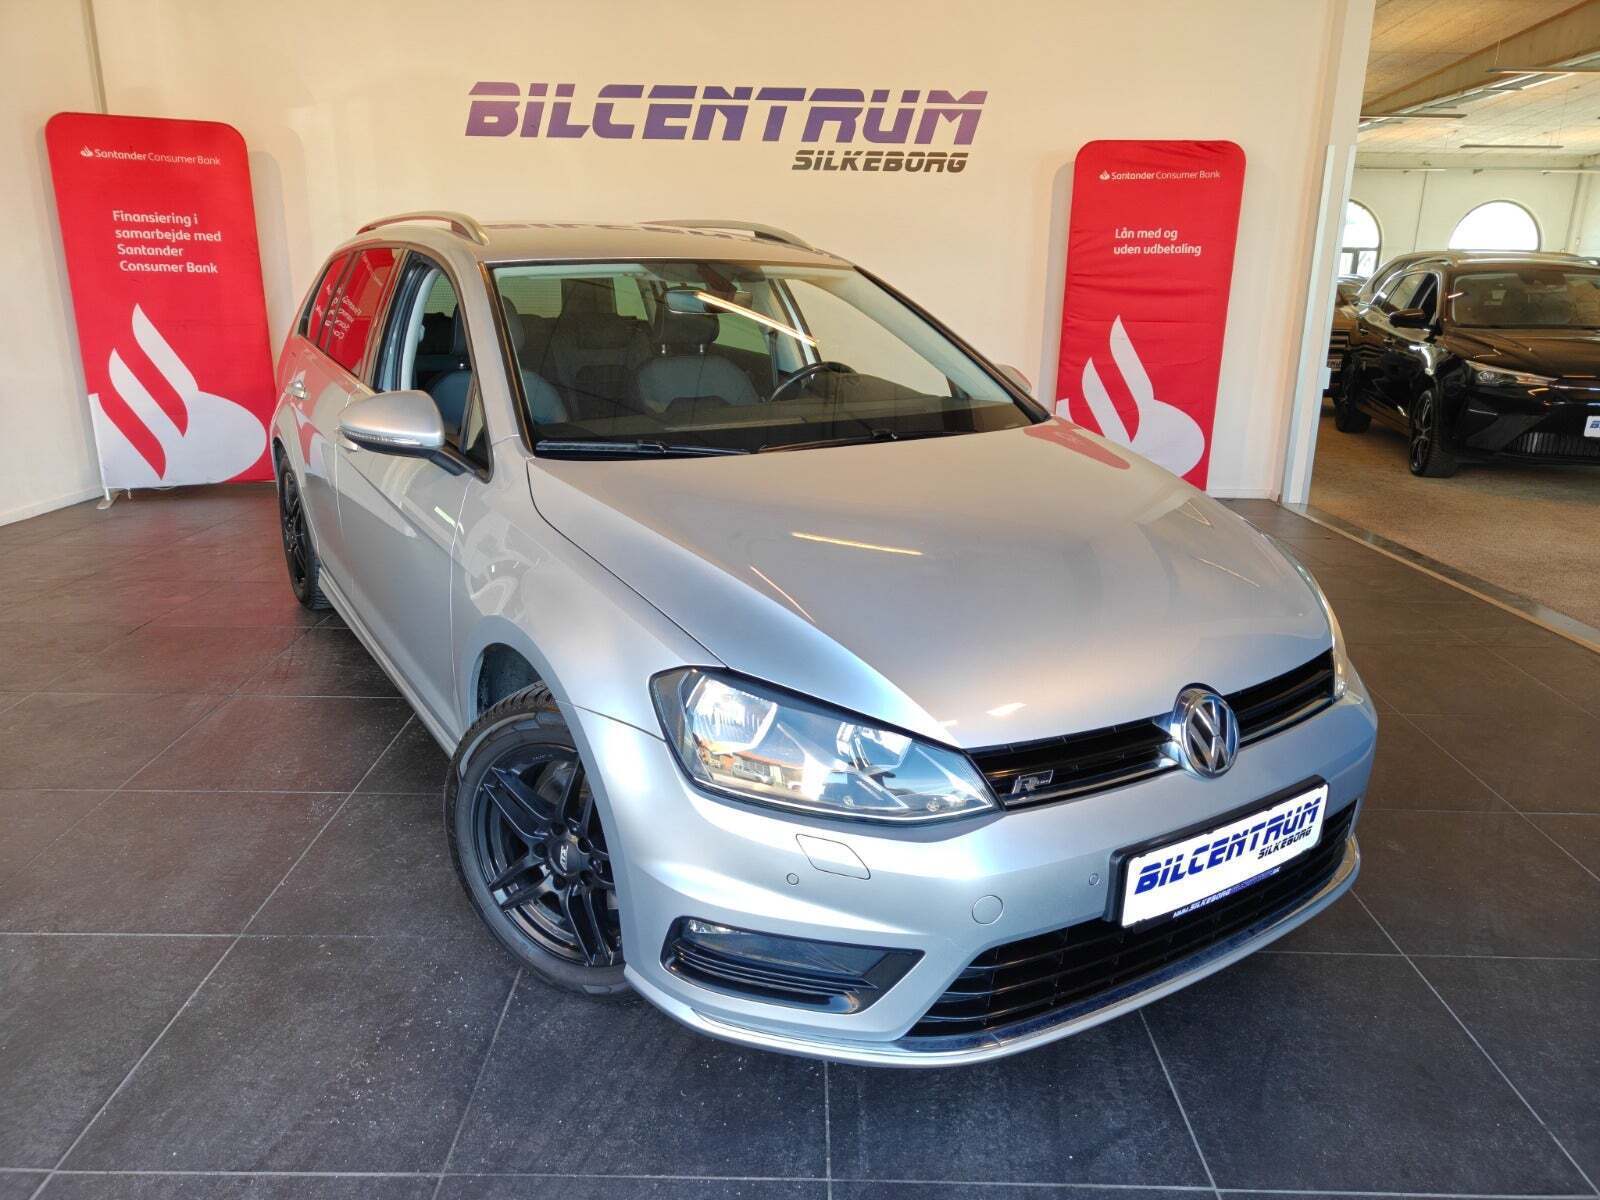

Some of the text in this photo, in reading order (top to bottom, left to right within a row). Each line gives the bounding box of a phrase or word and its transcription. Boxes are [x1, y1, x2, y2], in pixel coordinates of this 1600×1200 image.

[465, 81, 988, 145] BILCENTRUM
[94, 149, 221, 165] Santander Consumer Bank
[791, 150, 969, 173] SILKEBORG
[1111, 171, 1220, 180] Santander Consumer Bank
[113, 211, 198, 226] Finansiering i
[115, 227, 221, 243] samarbejde med
[1115, 228, 1178, 241] Lån med og
[118, 244, 183, 256] Santander
[1113, 243, 1202, 257] uden udbetaling
[120, 261, 218, 274] Consumer Bank
[1135, 797, 1321, 894] BILCENTRUM
[1257, 825, 1313, 860] SILKEBORG
